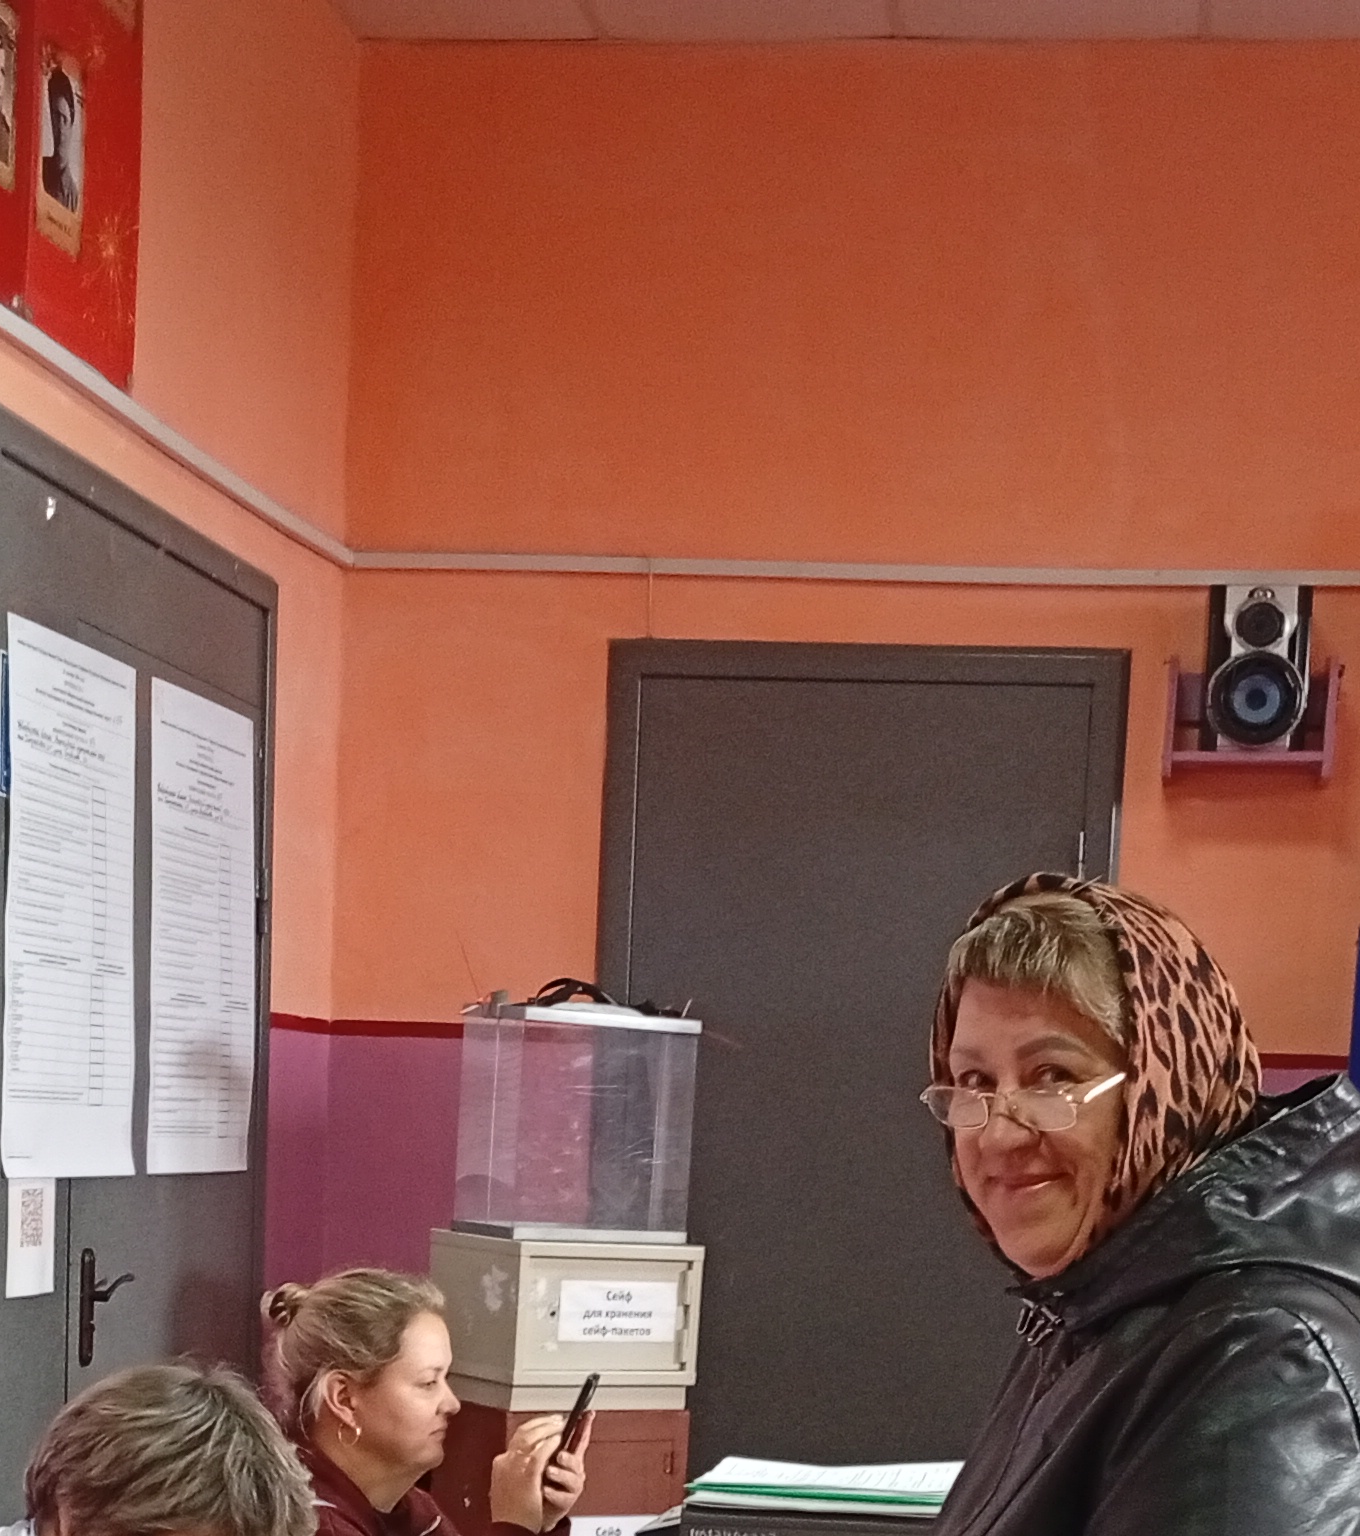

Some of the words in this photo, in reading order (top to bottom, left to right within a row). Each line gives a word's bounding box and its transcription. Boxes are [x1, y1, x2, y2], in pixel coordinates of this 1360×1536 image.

[606, 1290, 633, 1303] Сейф
[583, 1310, 602, 1320] для
[605, 1310, 653, 1320] хранения
[583, 1325, 651, 1337] сейф-пакетов
